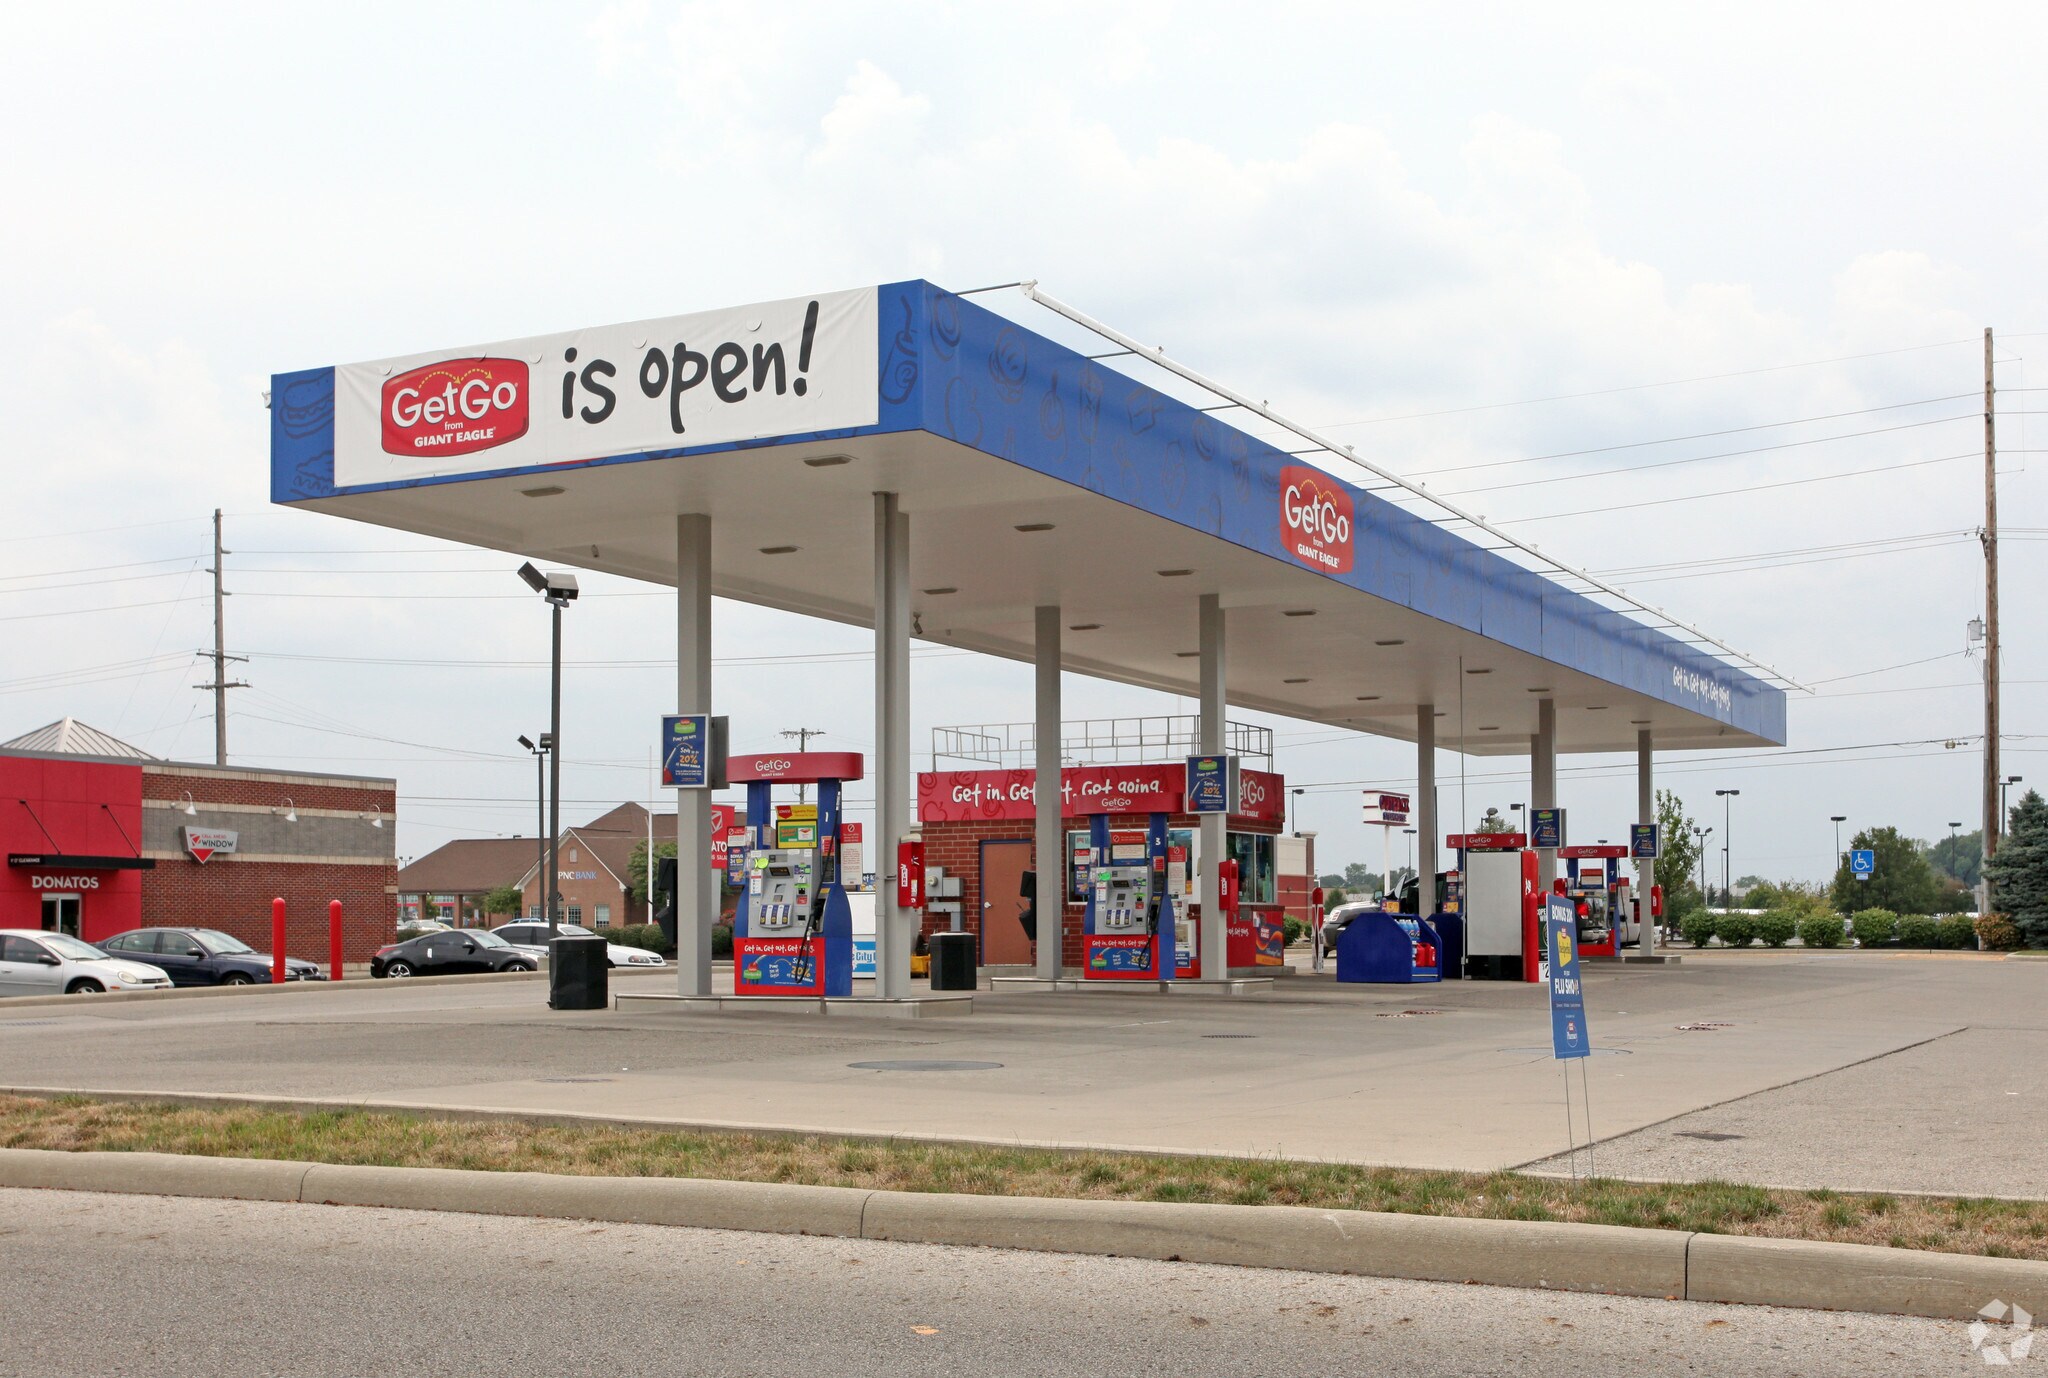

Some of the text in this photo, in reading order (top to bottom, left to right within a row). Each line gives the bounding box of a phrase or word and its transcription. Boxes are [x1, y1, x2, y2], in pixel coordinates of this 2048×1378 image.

[562, 300, 820, 435] is open!
[391, 378, 518, 428] GetGo
[444, 420, 464, 431] from
[413, 427, 494, 448] GIANT EAGLE
[1284, 484, 1349, 544] GetGo
[1297, 543, 1339, 569] GIANT EAGLE
[679, 754, 699, 765] 20%
[755, 759, 791, 771] GetGo
[952, 784, 982, 808] Get
[986, 783, 1006, 801] in.
[1240, 779, 1265, 805] etGo
[1101, 797, 1131, 807] GetGo
[201, 839, 234, 848] WINDOW
[1155, 837, 1161, 846] 3
[1468, 836, 1492, 844] GetGo
[557, 871, 597, 880] PNC BANK
[31, 875, 100, 889] DONATOS
[1551, 904, 1567, 922] BONUS
[744, 944, 755, 954] Get
[755, 944, 763, 952] in.
[763, 944, 775, 954] Get
[775, 945, 787, 954] out.
[787, 944, 799, 954] Get
[1091, 940, 1101, 948] Get
[856, 951, 874, 963] City
[1554, 977, 1565, 995] FLU
